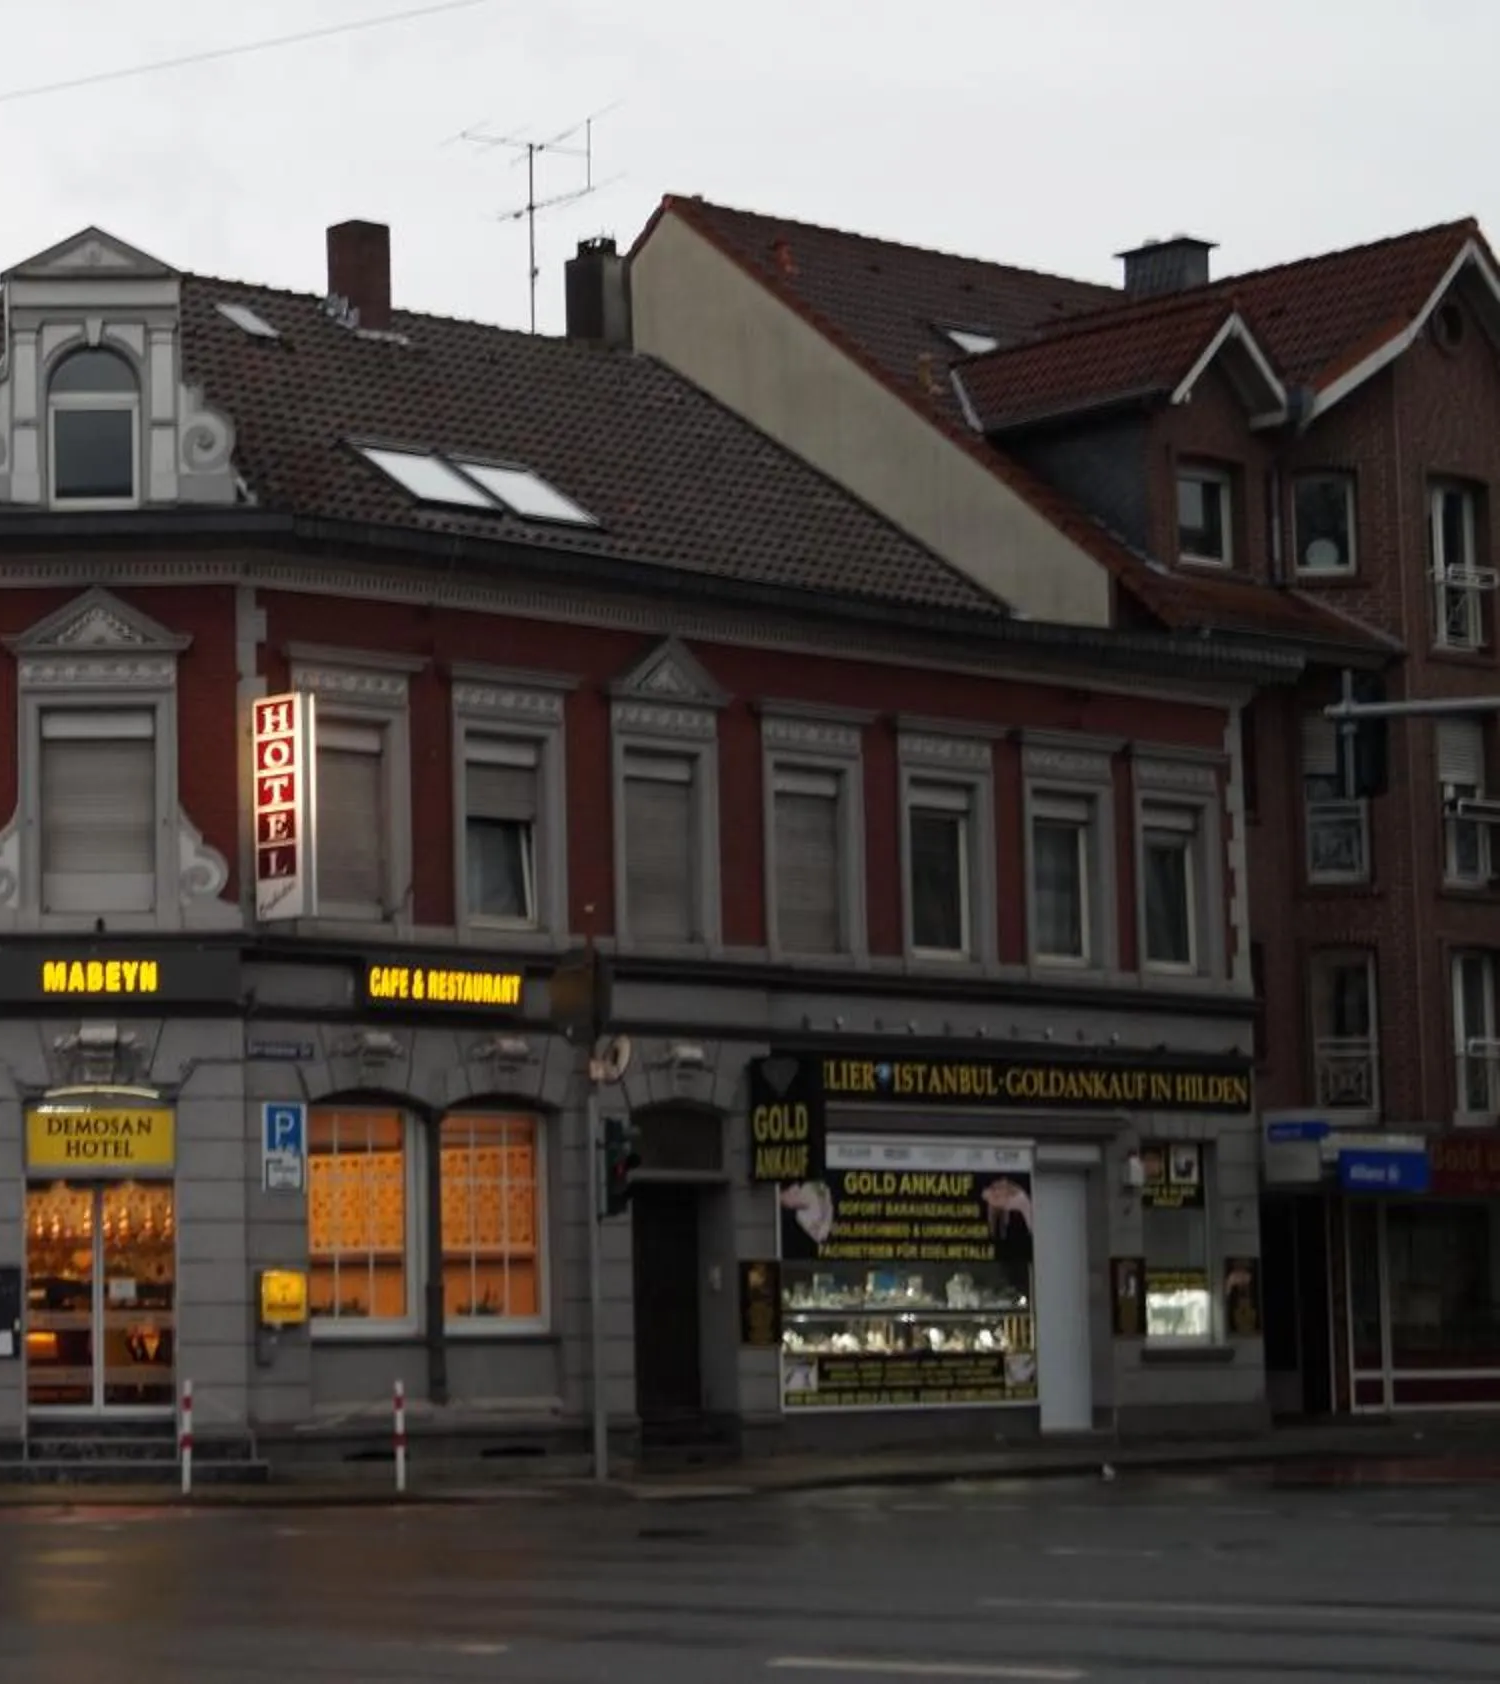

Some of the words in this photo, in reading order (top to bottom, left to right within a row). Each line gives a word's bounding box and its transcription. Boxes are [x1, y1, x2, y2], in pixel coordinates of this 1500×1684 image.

[263, 704, 291, 878] HOTEL
[43, 961, 158, 992] MABEYN
[370, 966, 409, 998] CAFE
[412, 969, 424, 999] &
[428, 970, 521, 1005] RESTAURANT
[893, 1062, 997, 1095] ISTANBUL
[1006, 1067, 1148, 1099] GOLDANKAUF
[1151, 1070, 1171, 1099] IN
[1176, 1073, 1248, 1104] HILDEN
[47, 1117, 152, 1137] DEMOSAN
[275, 1110, 295, 1147] P
[753, 1103, 808, 1142] GOLD
[66, 1139, 134, 1158] HOTEL
[755, 1146, 809, 1177] ANKAUF
[844, 1171, 896, 1196] GOLD
[900, 1174, 975, 1197] ANKAUF
[838, 1201, 882, 1217] SOFORT
